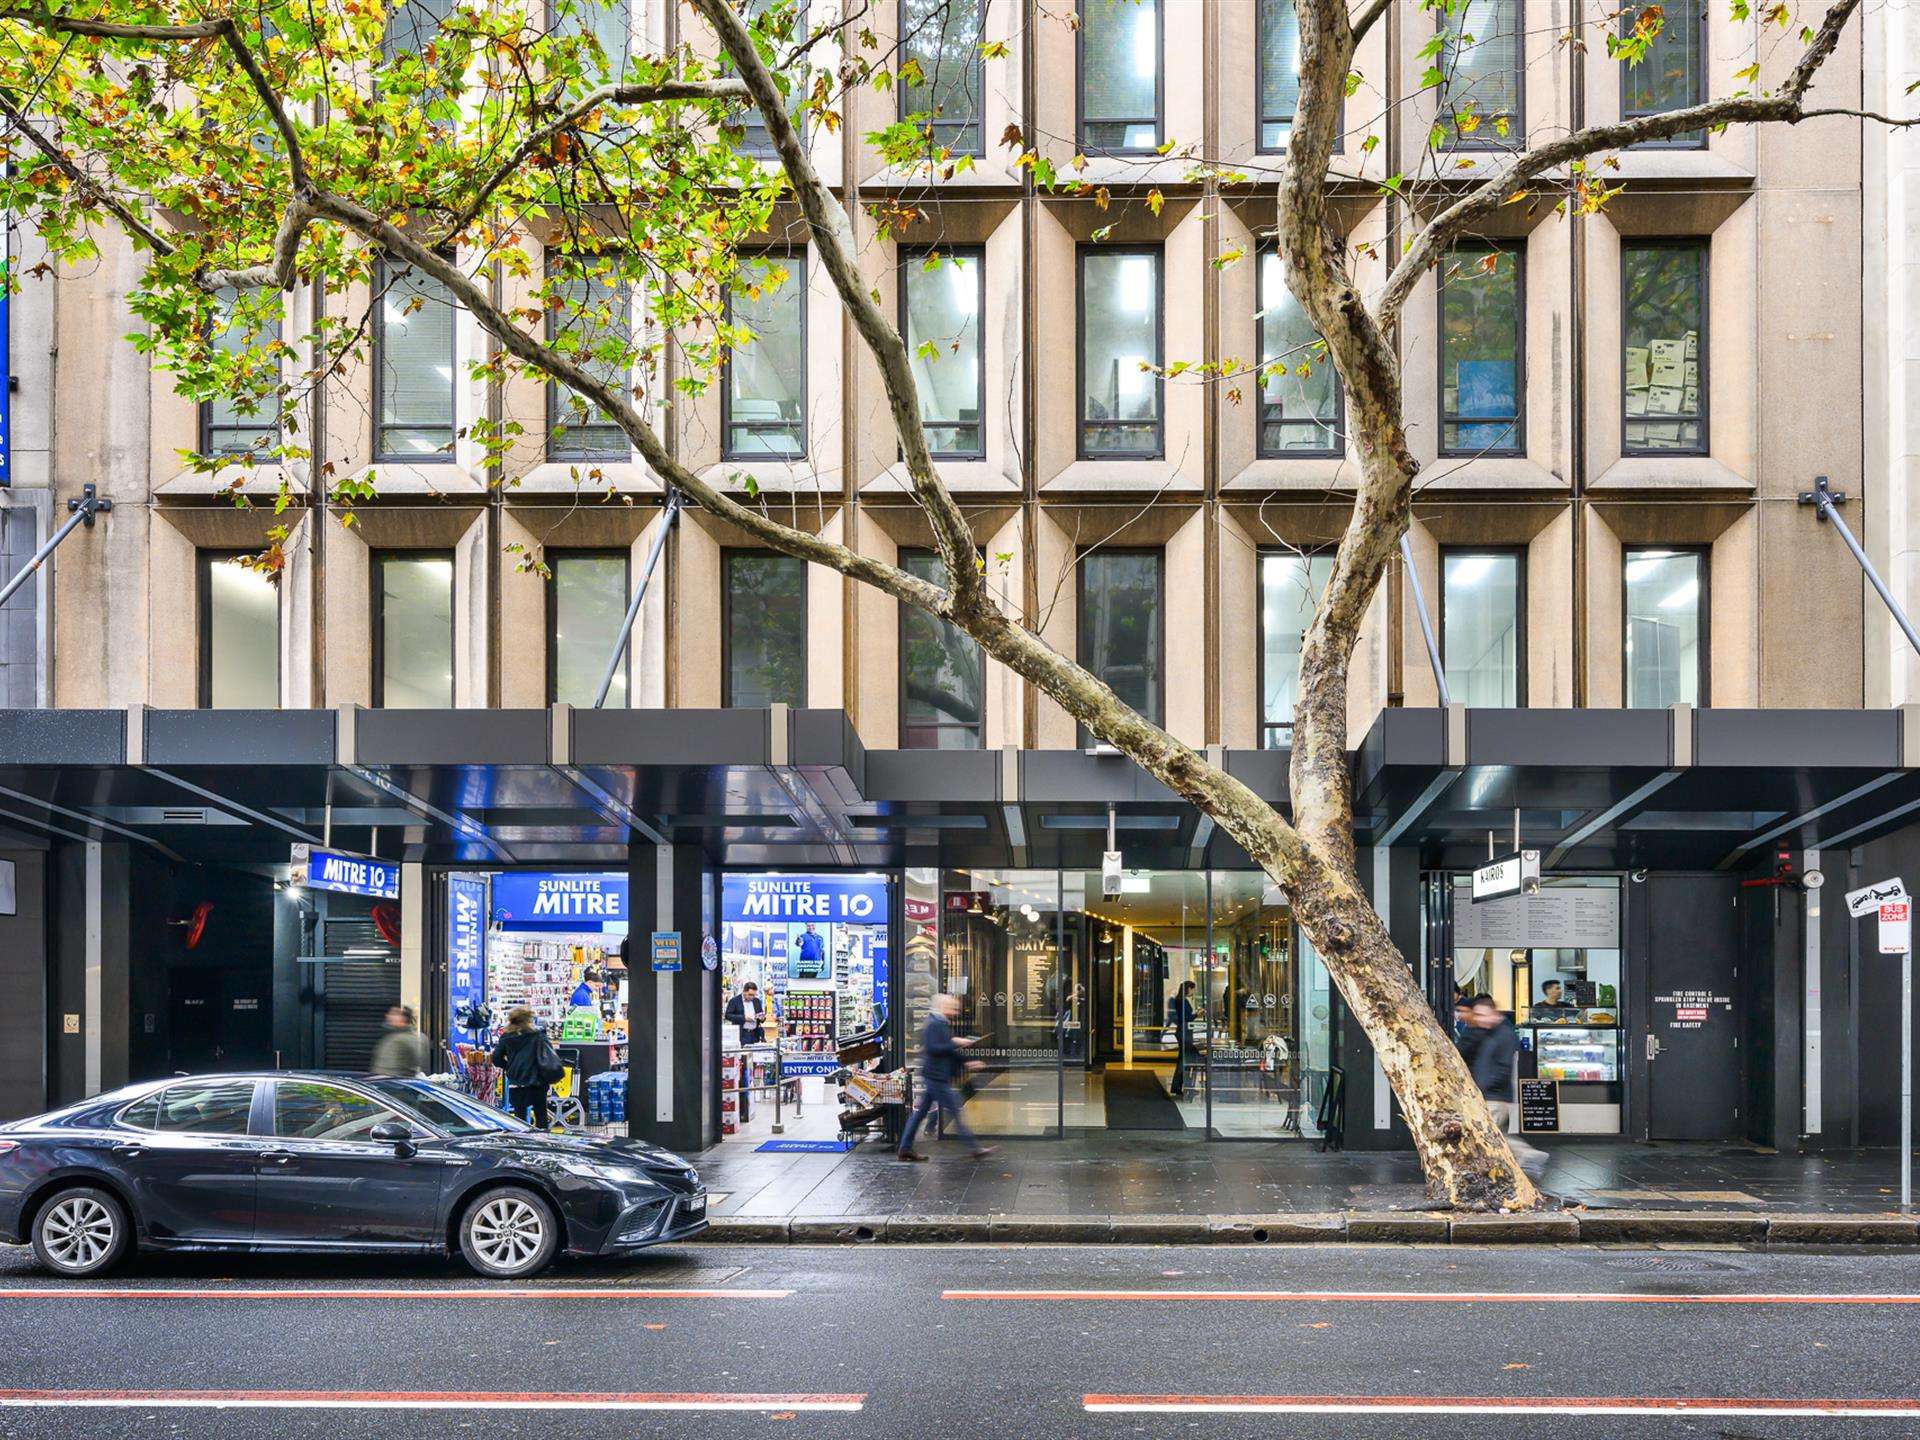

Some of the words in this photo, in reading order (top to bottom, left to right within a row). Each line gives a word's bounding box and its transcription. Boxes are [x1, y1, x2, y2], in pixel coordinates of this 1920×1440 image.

[323, 858, 366, 885] MITRE
[370, 866, 385, 887] 10
[1480, 864, 1504, 884] KAIROS
[539, 880, 601, 892] SUNLITE
[748, 881, 811, 893] SUNLITE
[532, 892, 620, 915] MITRE
[741, 893, 831, 916] MITRE
[839, 893, 874, 916] 10
[1884, 904, 1904, 912] BUS
[1881, 912, 1907, 920] ZONE
[456, 891, 471, 988] MITRE
[469, 900, 478, 968] SUNLITE
[783, 1065, 814, 1074] ENTRY
